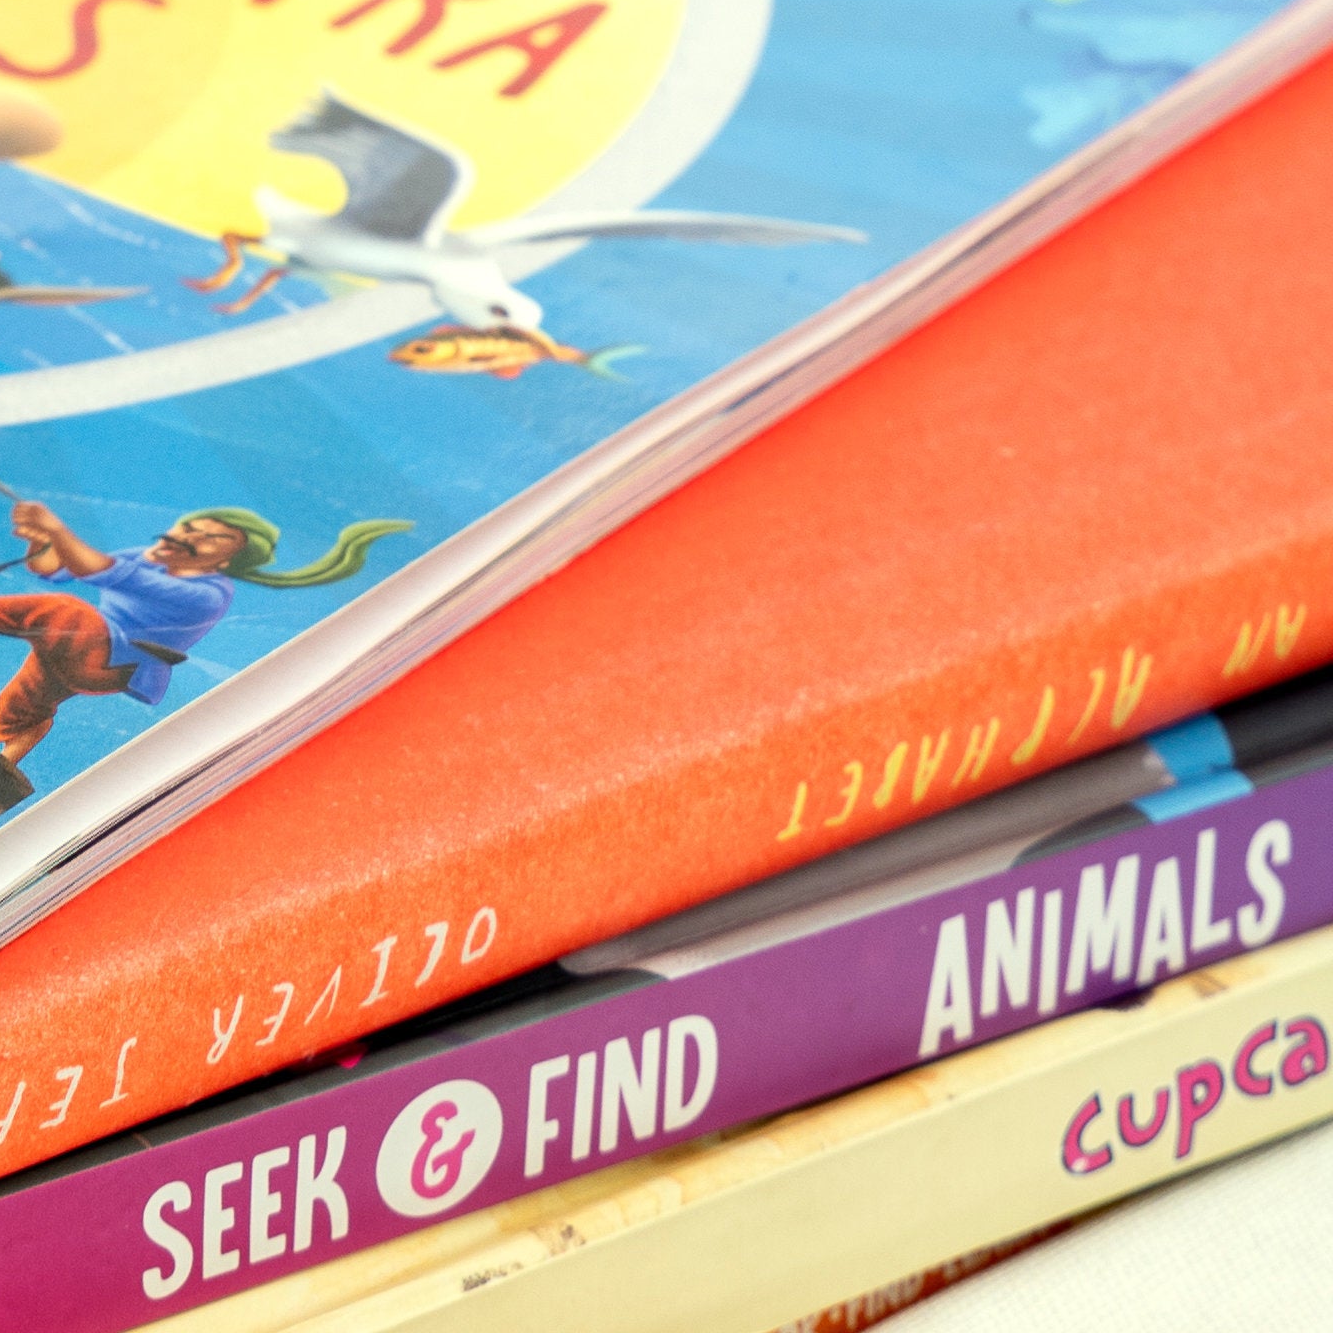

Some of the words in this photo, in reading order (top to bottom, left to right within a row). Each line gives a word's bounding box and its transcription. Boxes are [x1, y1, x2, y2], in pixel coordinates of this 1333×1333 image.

[1221, 603, 1307, 678] AN
[775, 646, 1154, 843] ALPHABET
[141, 1124, 350, 1301] SEEK
[410, 1100, 476, 1200] &
[523, 1013, 719, 1178] FIND
[918, 818, 1293, 1057] ANIMALS
[205, 905, 498, 1065] OLIVER
